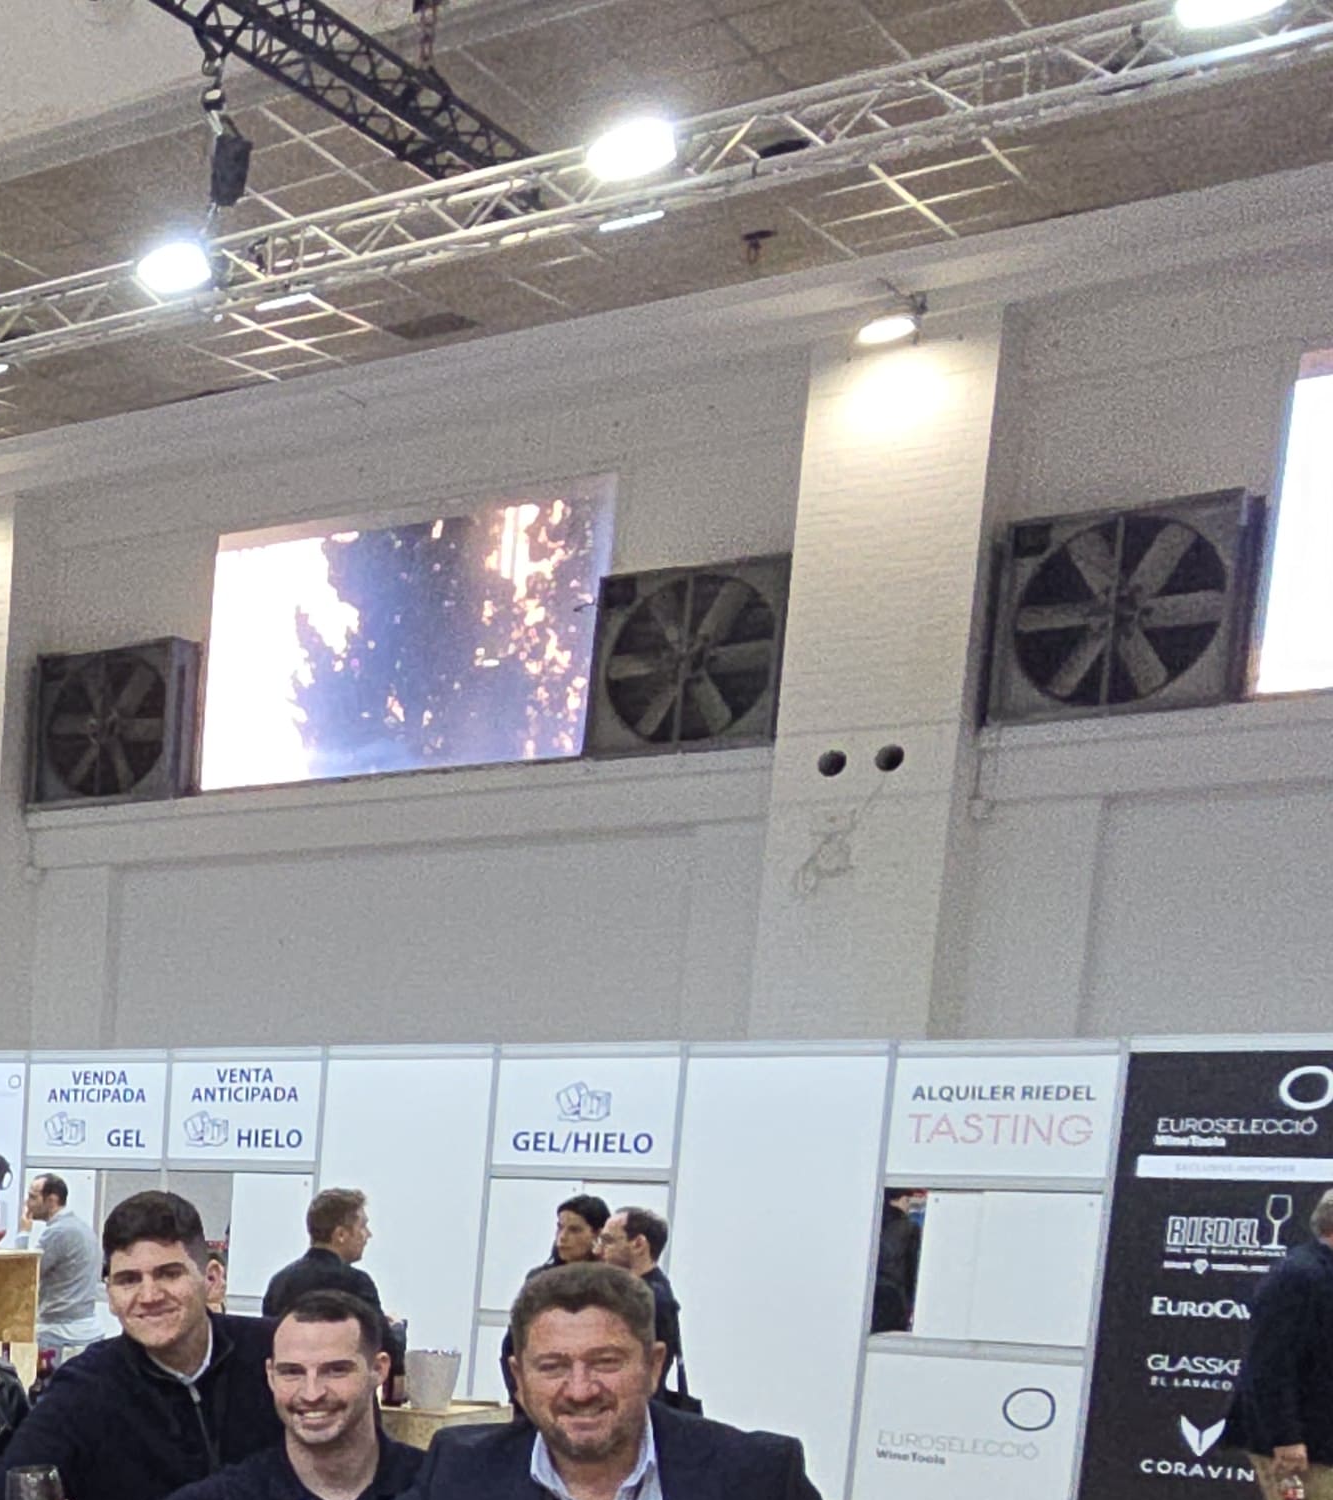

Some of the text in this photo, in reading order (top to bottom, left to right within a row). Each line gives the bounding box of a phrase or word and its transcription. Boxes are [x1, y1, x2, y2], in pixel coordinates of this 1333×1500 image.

[71, 1069, 128, 1087] VENDA
[217, 1067, 274, 1085] VENTA
[47, 1087, 147, 1104] ANTICIPADA
[191, 1085, 299, 1103] ANTICIPADA
[912, 1084, 1097, 1103] ALQUILER RIEDEL
[907, 1113, 1094, 1147] TASTING
[1156, 1115, 1319, 1135] EUROSELECCIÓ
[107, 1128, 146, 1149] GEL
[237, 1127, 303, 1149] HIELO
[512, 1130, 654, 1155] GEL/HIELO
[1166, 1215, 1261, 1248] RIEDEL
[877, 1429, 1040, 1461] EUROSELECCIÓ
[1140, 1459, 1256, 1483] CORAVIN
